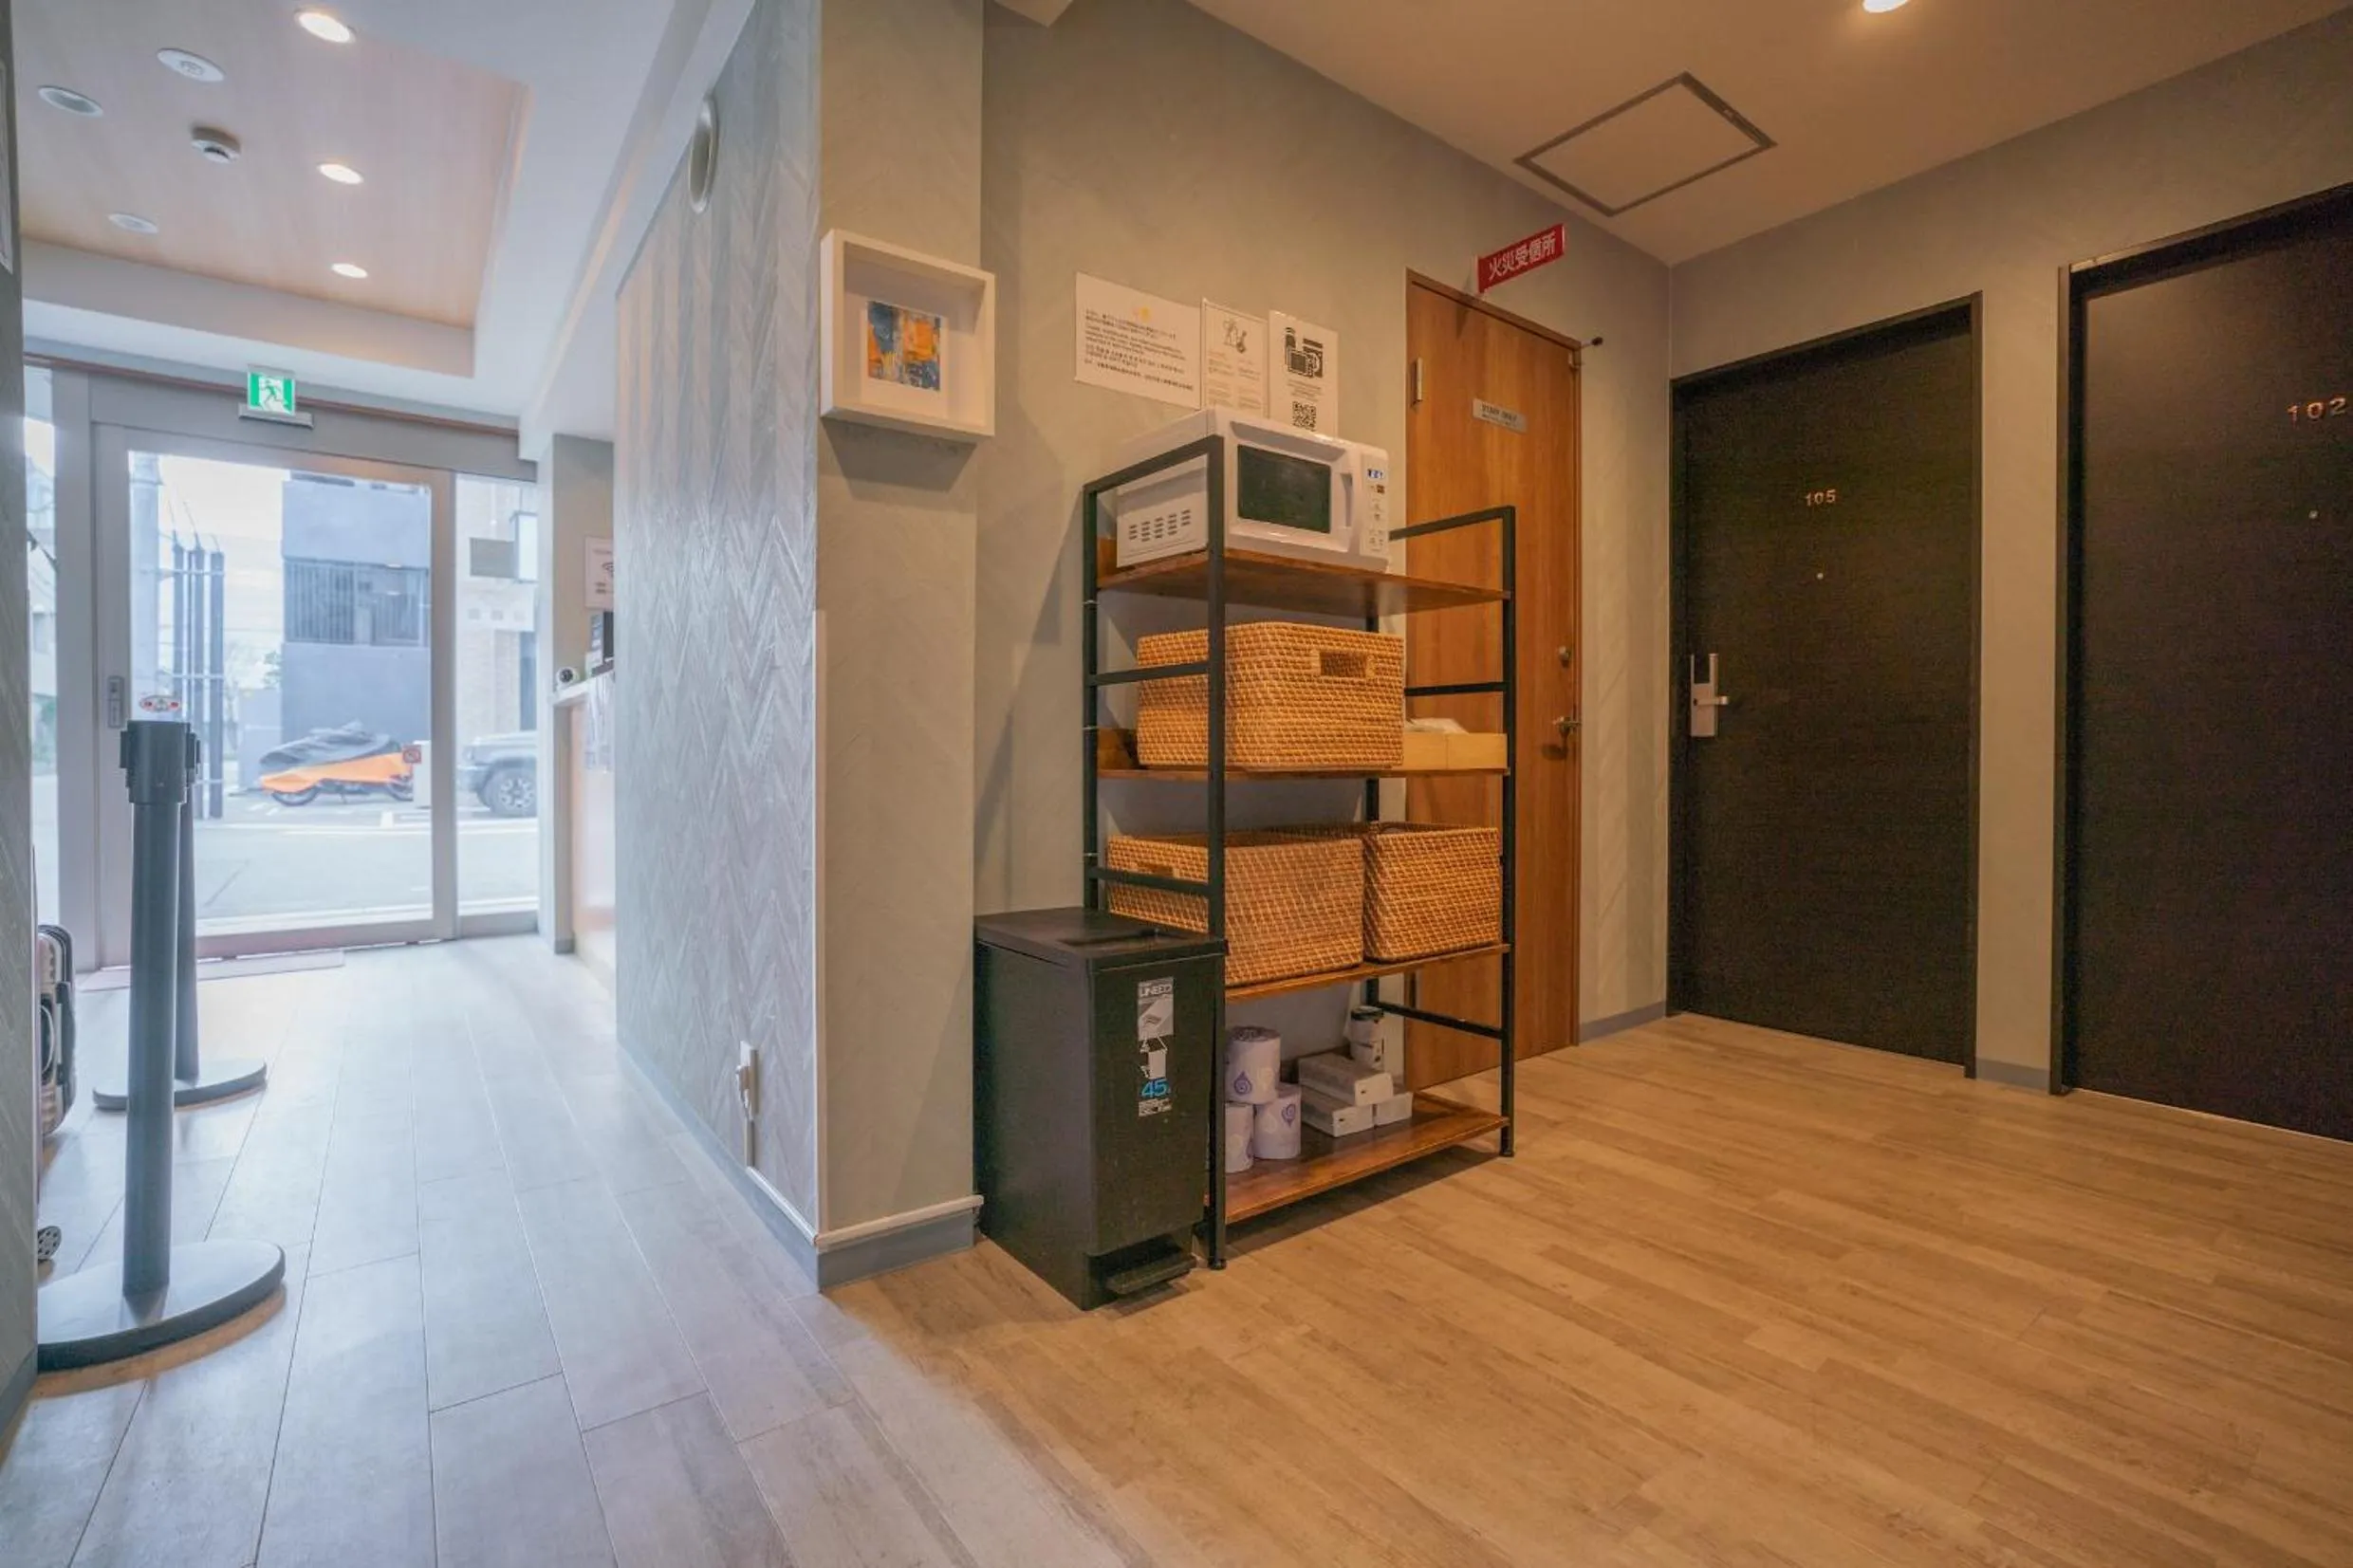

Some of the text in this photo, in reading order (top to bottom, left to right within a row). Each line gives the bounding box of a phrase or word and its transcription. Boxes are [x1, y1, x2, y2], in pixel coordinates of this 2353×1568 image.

[2288, 397, 2345, 427] 102
[1805, 489, 1836, 507] 105
[1141, 1078, 1168, 1098] 45
